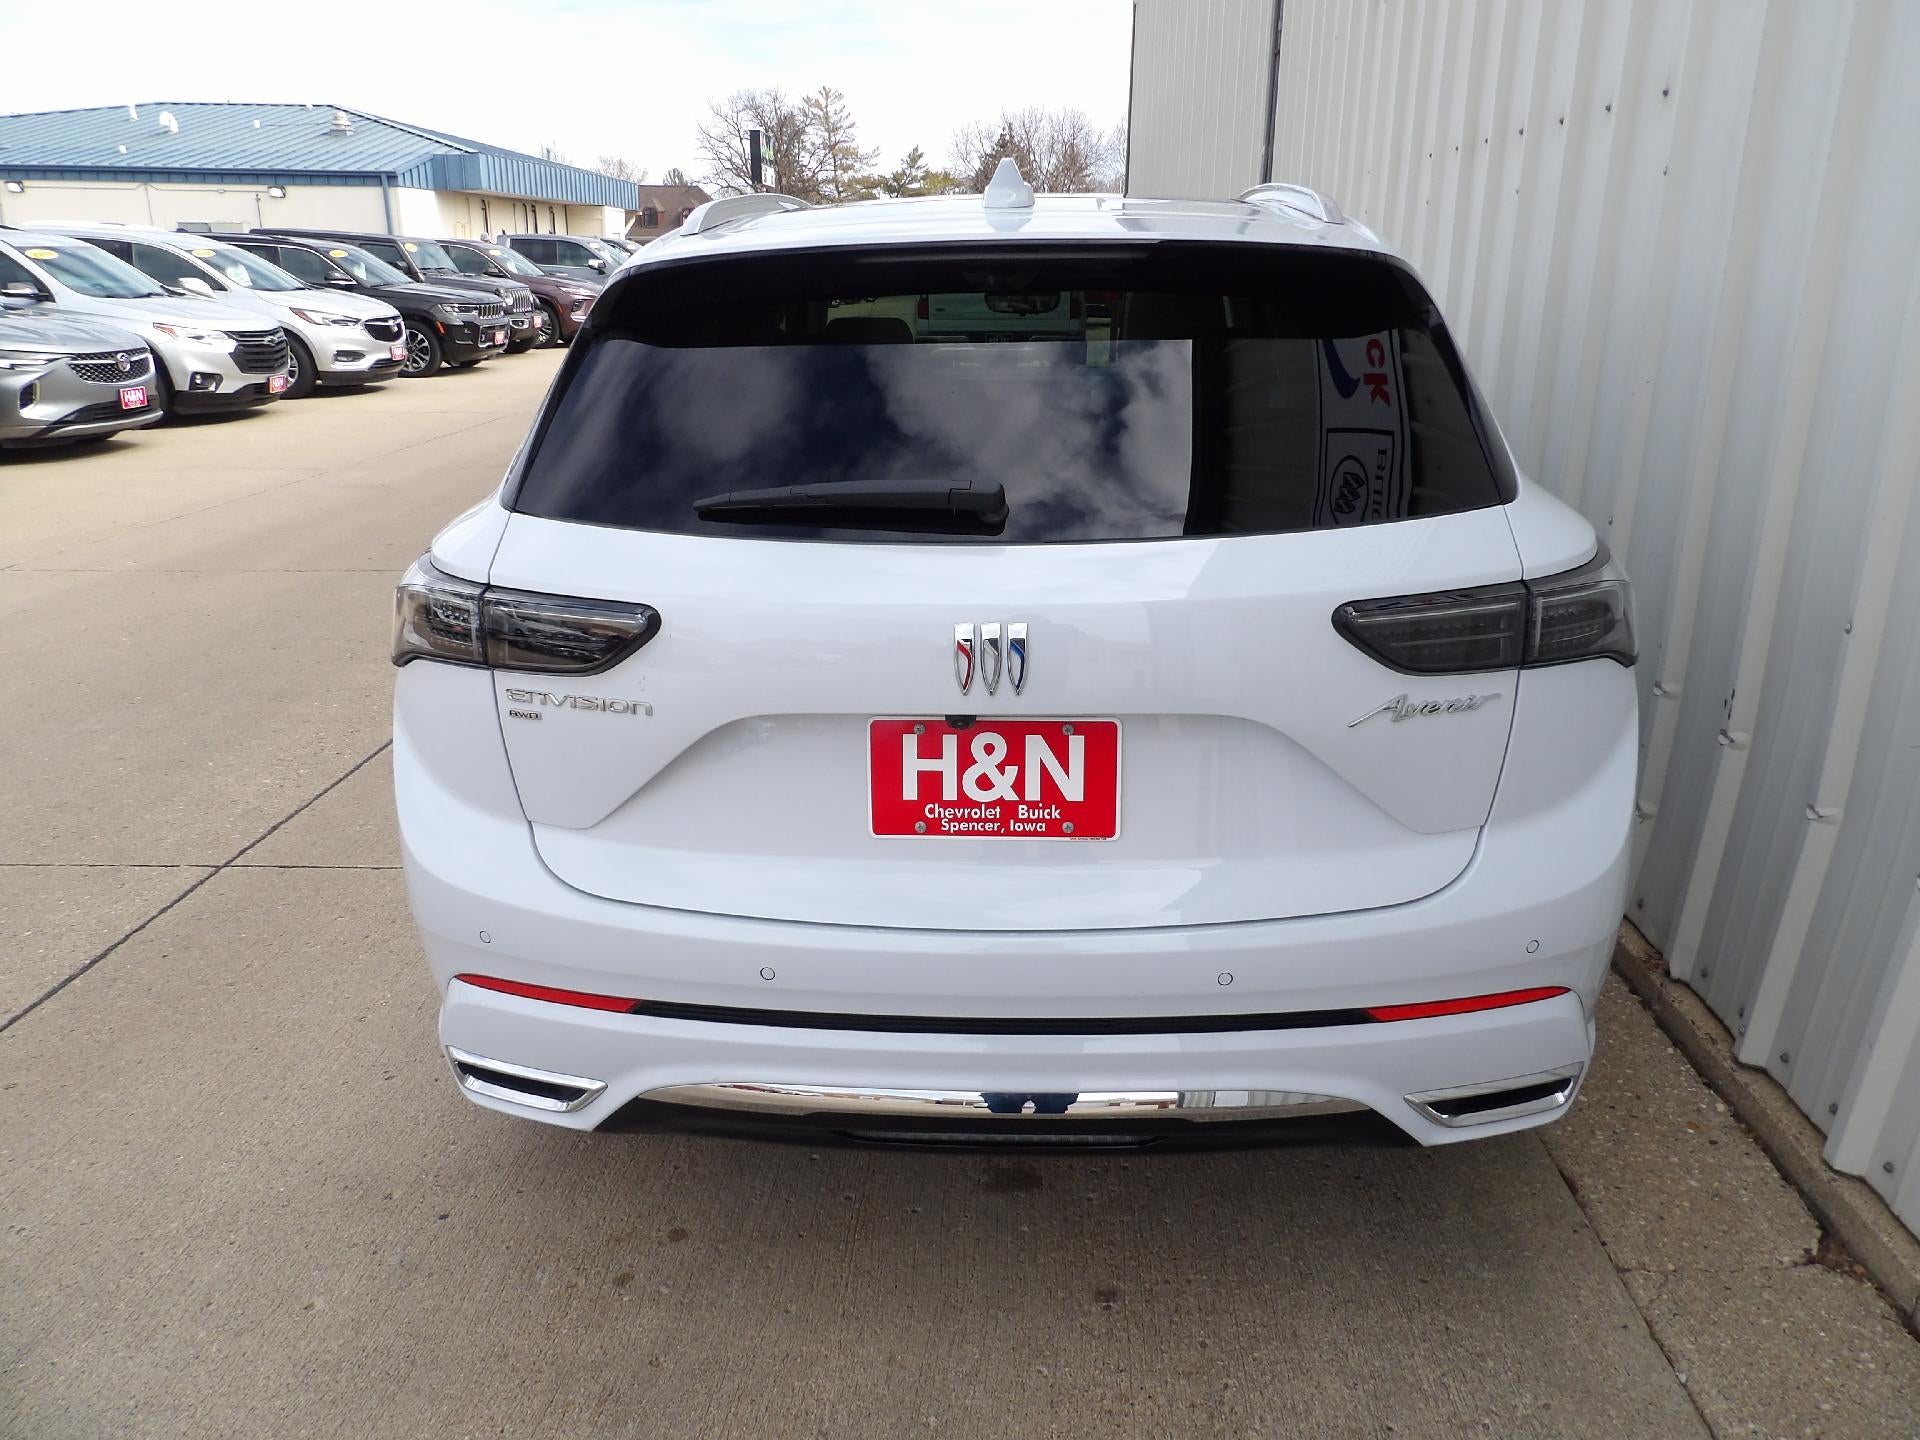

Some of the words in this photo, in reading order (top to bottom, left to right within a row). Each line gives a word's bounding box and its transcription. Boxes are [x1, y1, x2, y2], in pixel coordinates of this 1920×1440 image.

[124, 388, 144, 403] H&N
[505, 687, 654, 717] ENVISION
[1347, 692, 1502, 728] Avenir
[901, 731, 1086, 803] H&N
[924, 803, 1001, 819] Chevrolet
[1017, 803, 1061, 819] Buick
[941, 819, 1005, 834] Spencer,
[1009, 819, 1046, 832] Iowa
